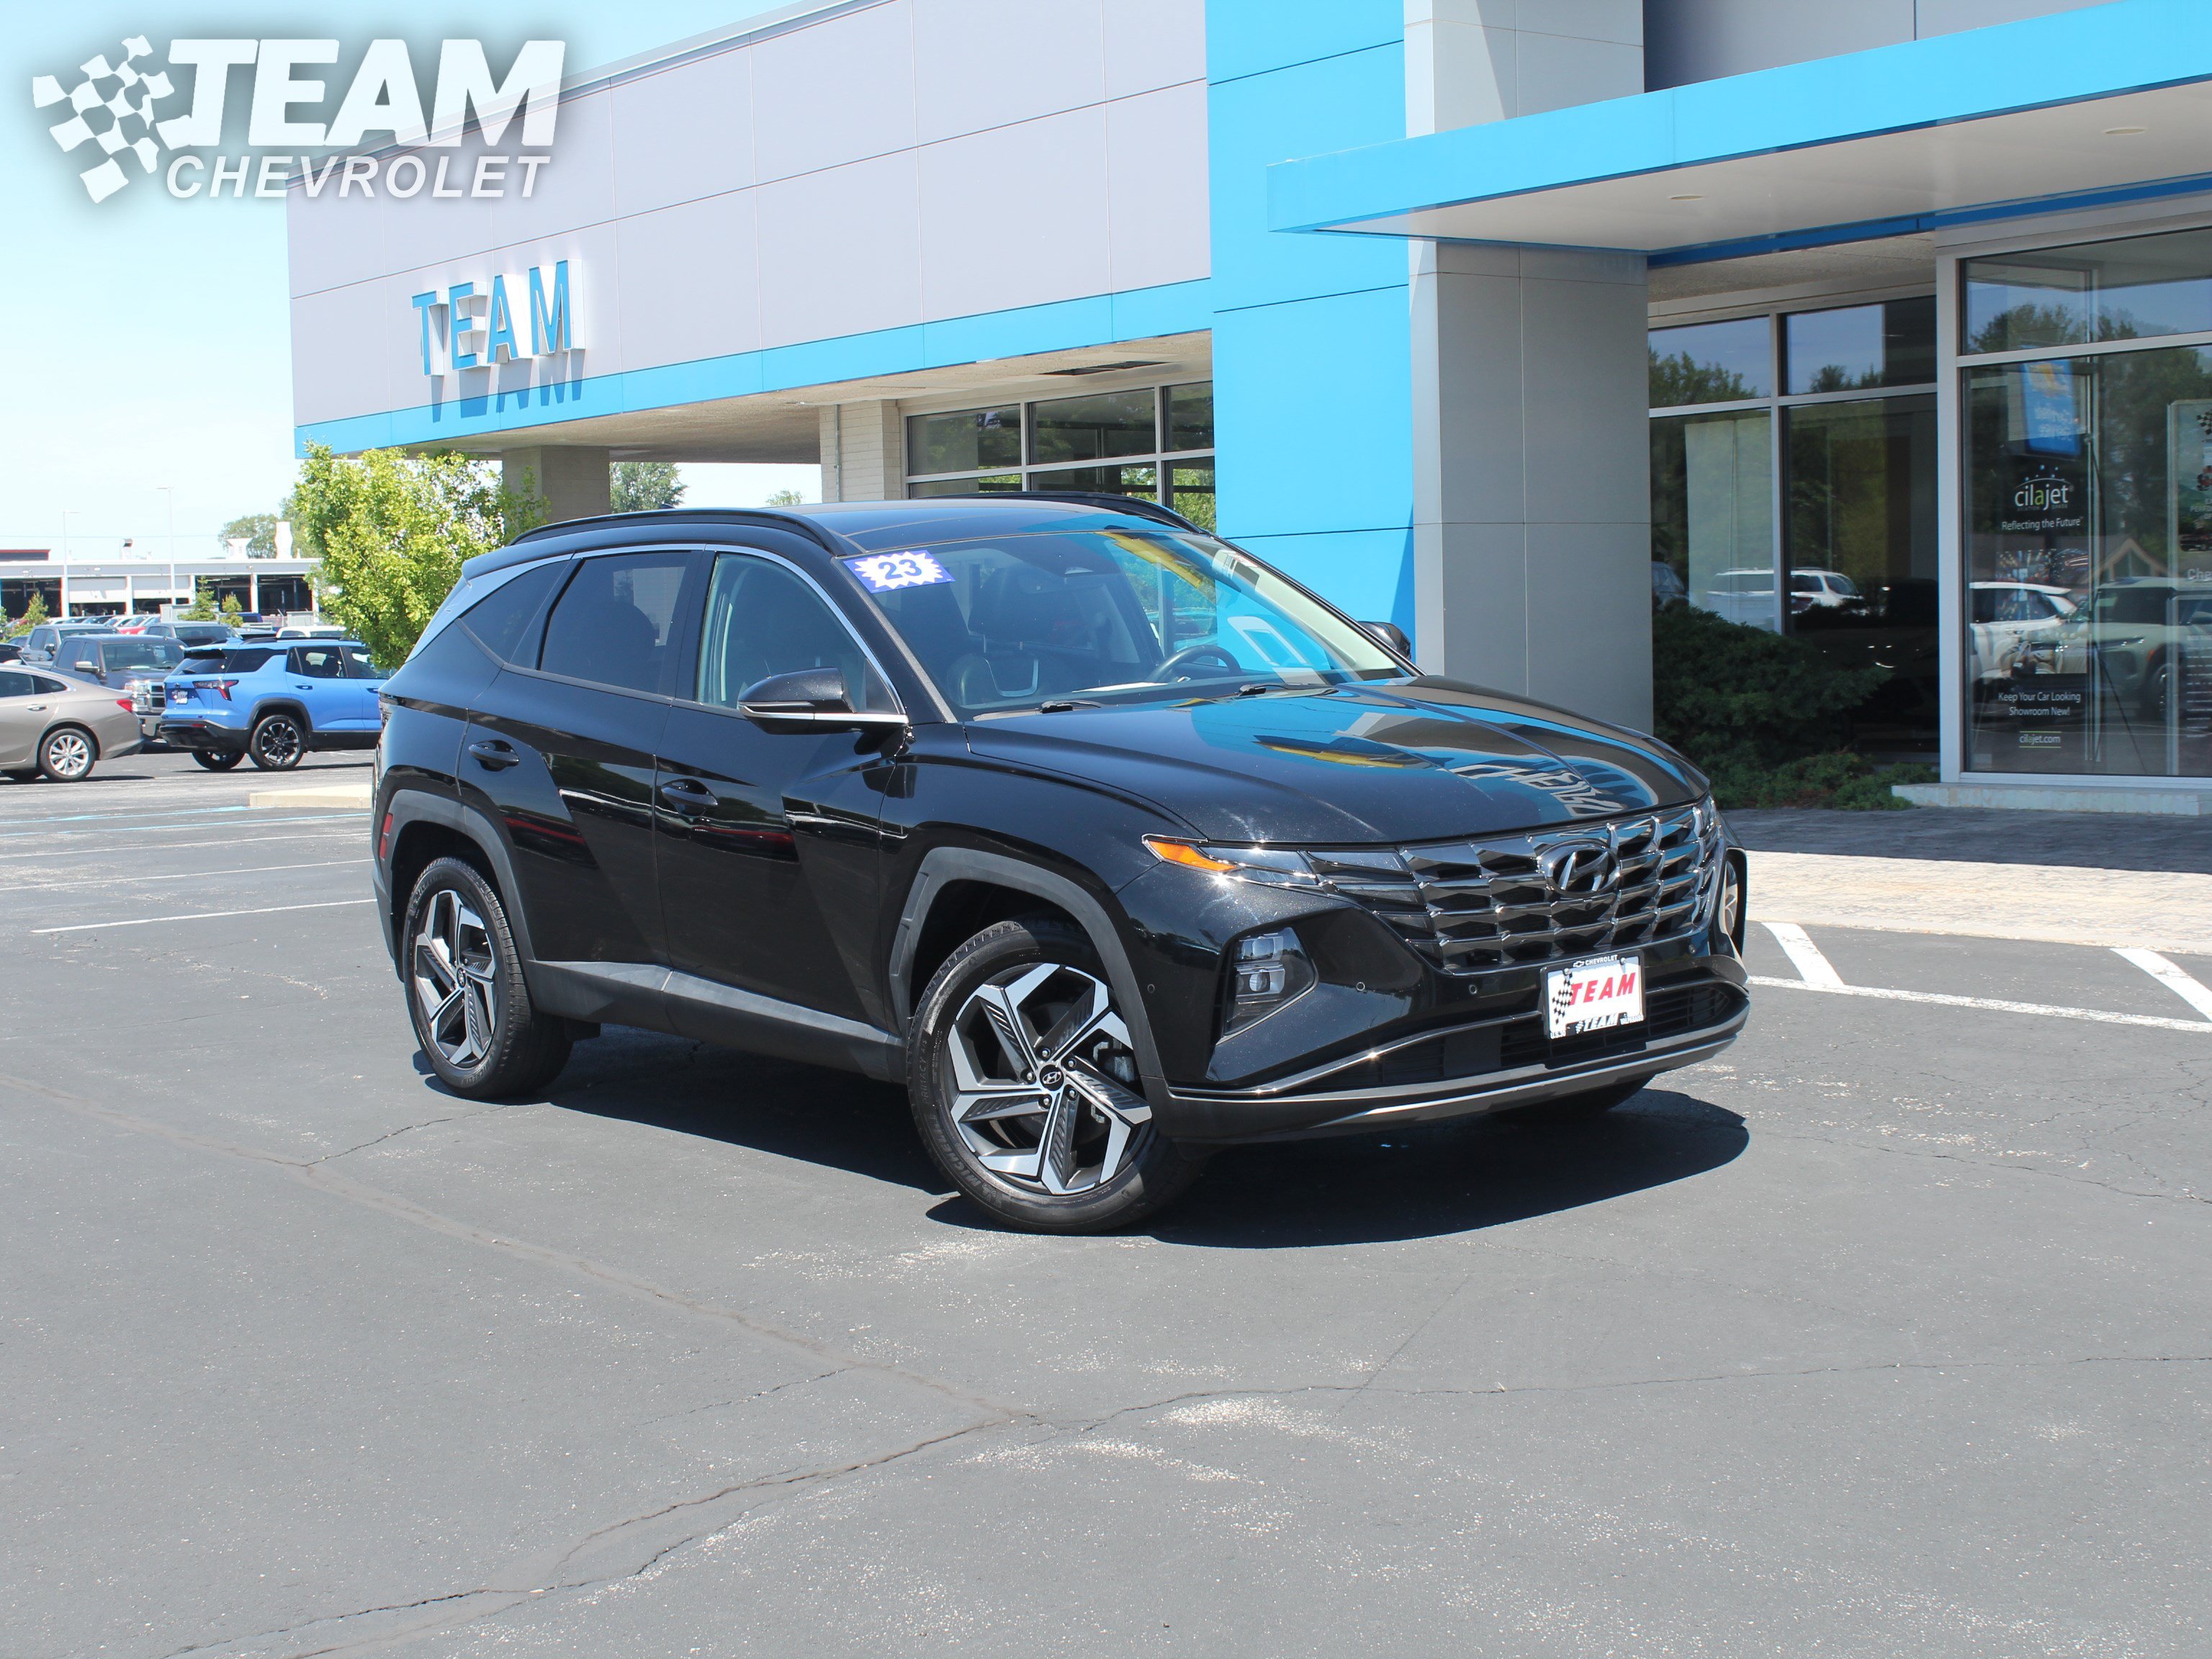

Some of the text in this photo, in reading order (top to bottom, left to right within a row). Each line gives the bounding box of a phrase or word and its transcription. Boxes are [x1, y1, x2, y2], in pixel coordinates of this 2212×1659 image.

[412, 259, 580, 376] TEAM
[2014, 484, 2069, 511] cilajet
[2002, 518, 2080, 531] Reflecting the Future
[878, 559, 922, 580] 23
[1998, 692, 2081, 703] Keep Your Car Looking
[2009, 706, 2070, 715] Showroom New!
[2019, 734, 2061, 745] cilajet.com
[1585, 954, 1618, 966] CHEVROLET
[1570, 972, 1636, 1006] TEAM
[1583, 1012, 1619, 1031] TEAM
